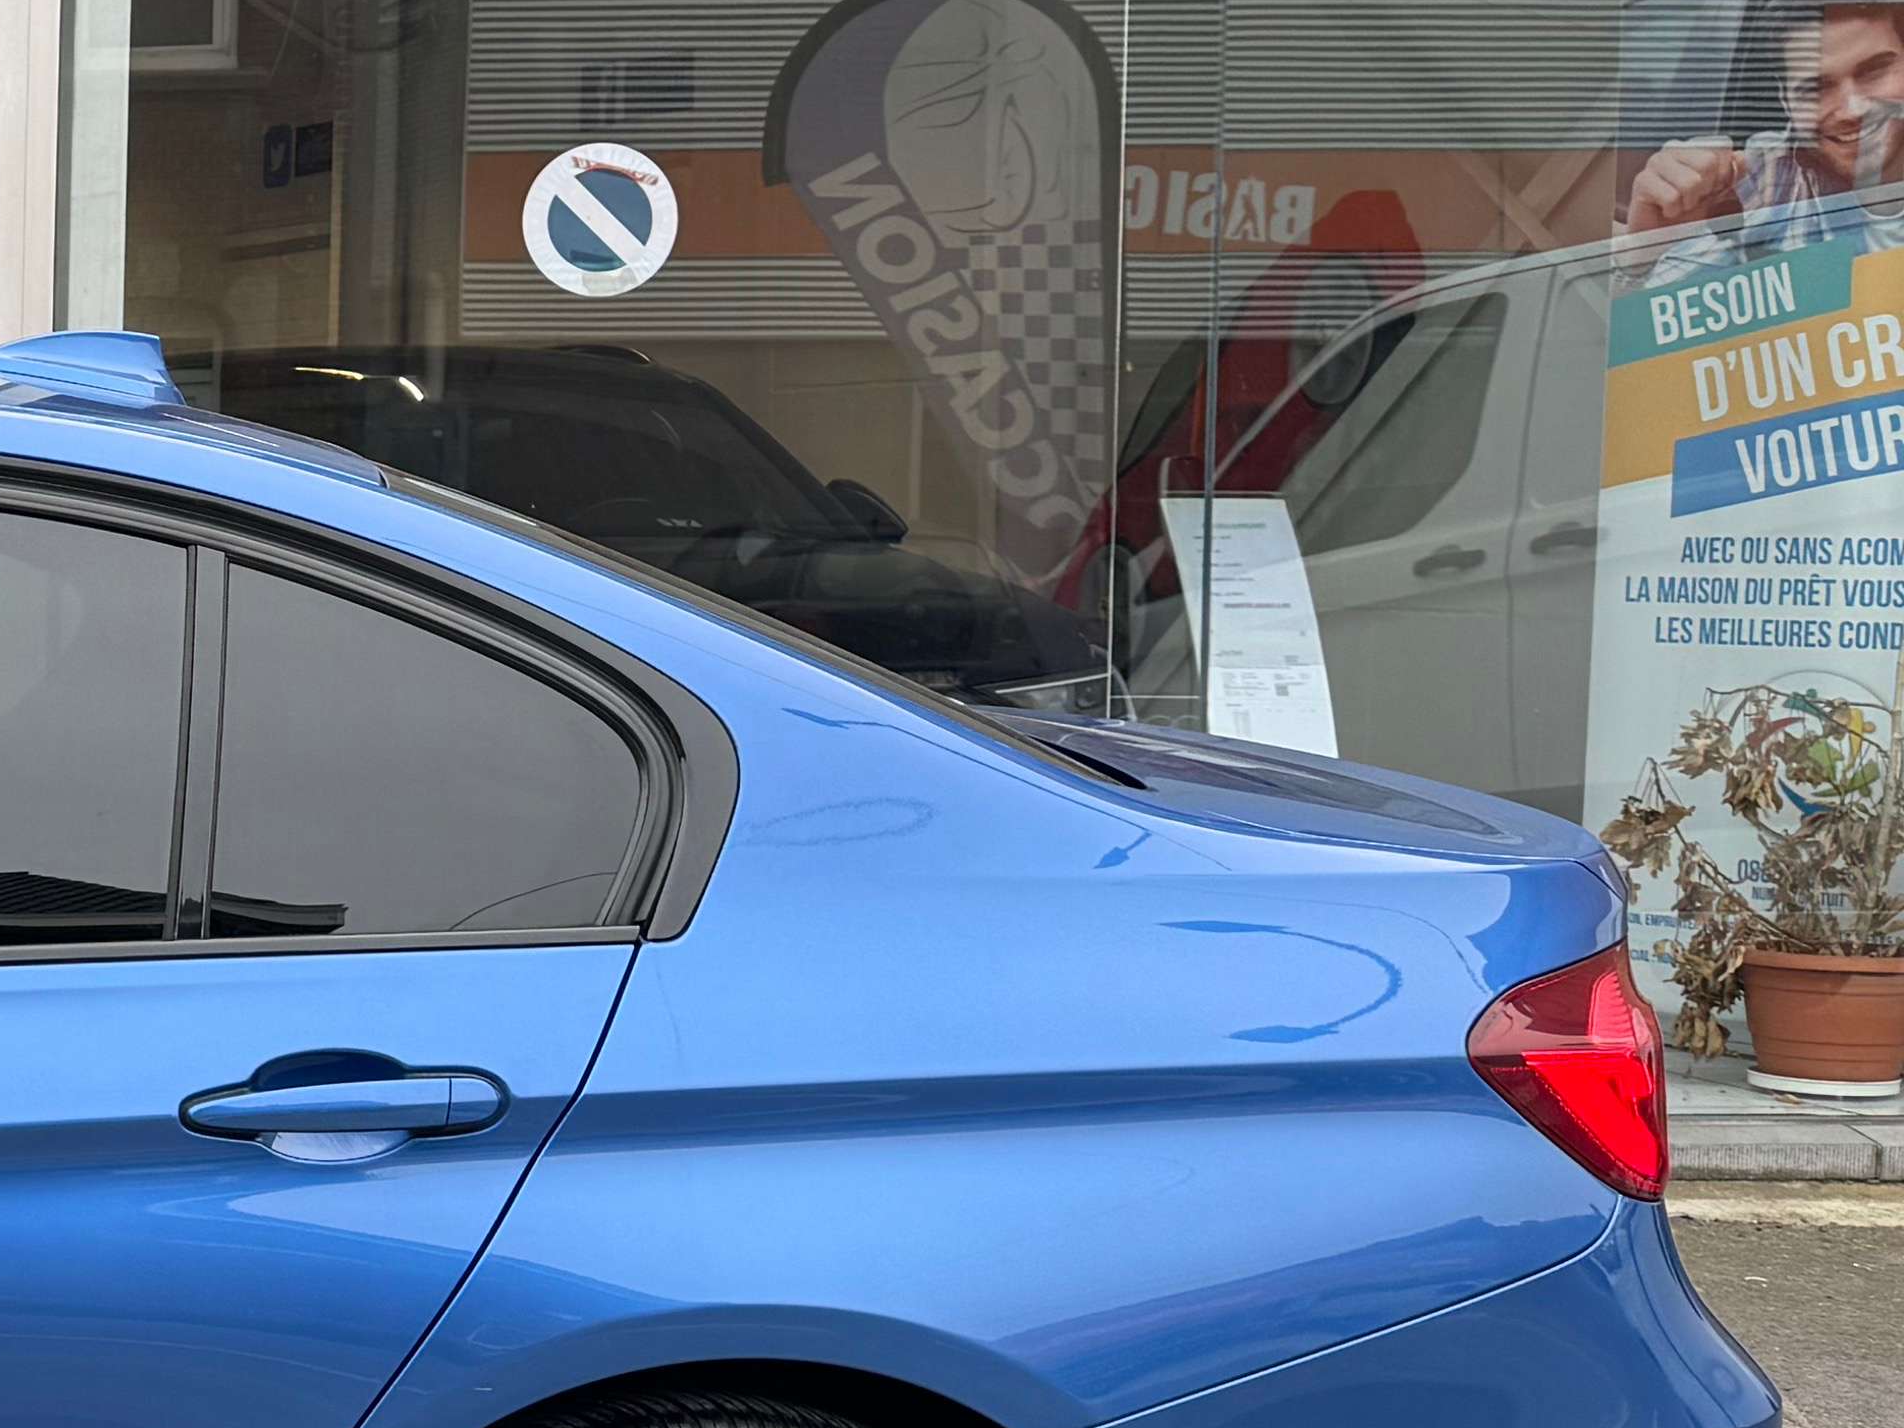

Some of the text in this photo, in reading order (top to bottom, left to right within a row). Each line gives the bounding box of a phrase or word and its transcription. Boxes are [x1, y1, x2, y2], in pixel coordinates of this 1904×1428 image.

[1650, 262, 1797, 346] BESOIN
[1681, 536, 1735, 563] AVEC
[1740, 536, 1769, 564] OU
[1774, 537, 1833, 565] SANS
[1625, 573, 1904, 608] LA MAISON DU PRÊT VOUS
[1655, 617, 1693, 644] LES
[1698, 617, 1832, 648] MEILLEURES
